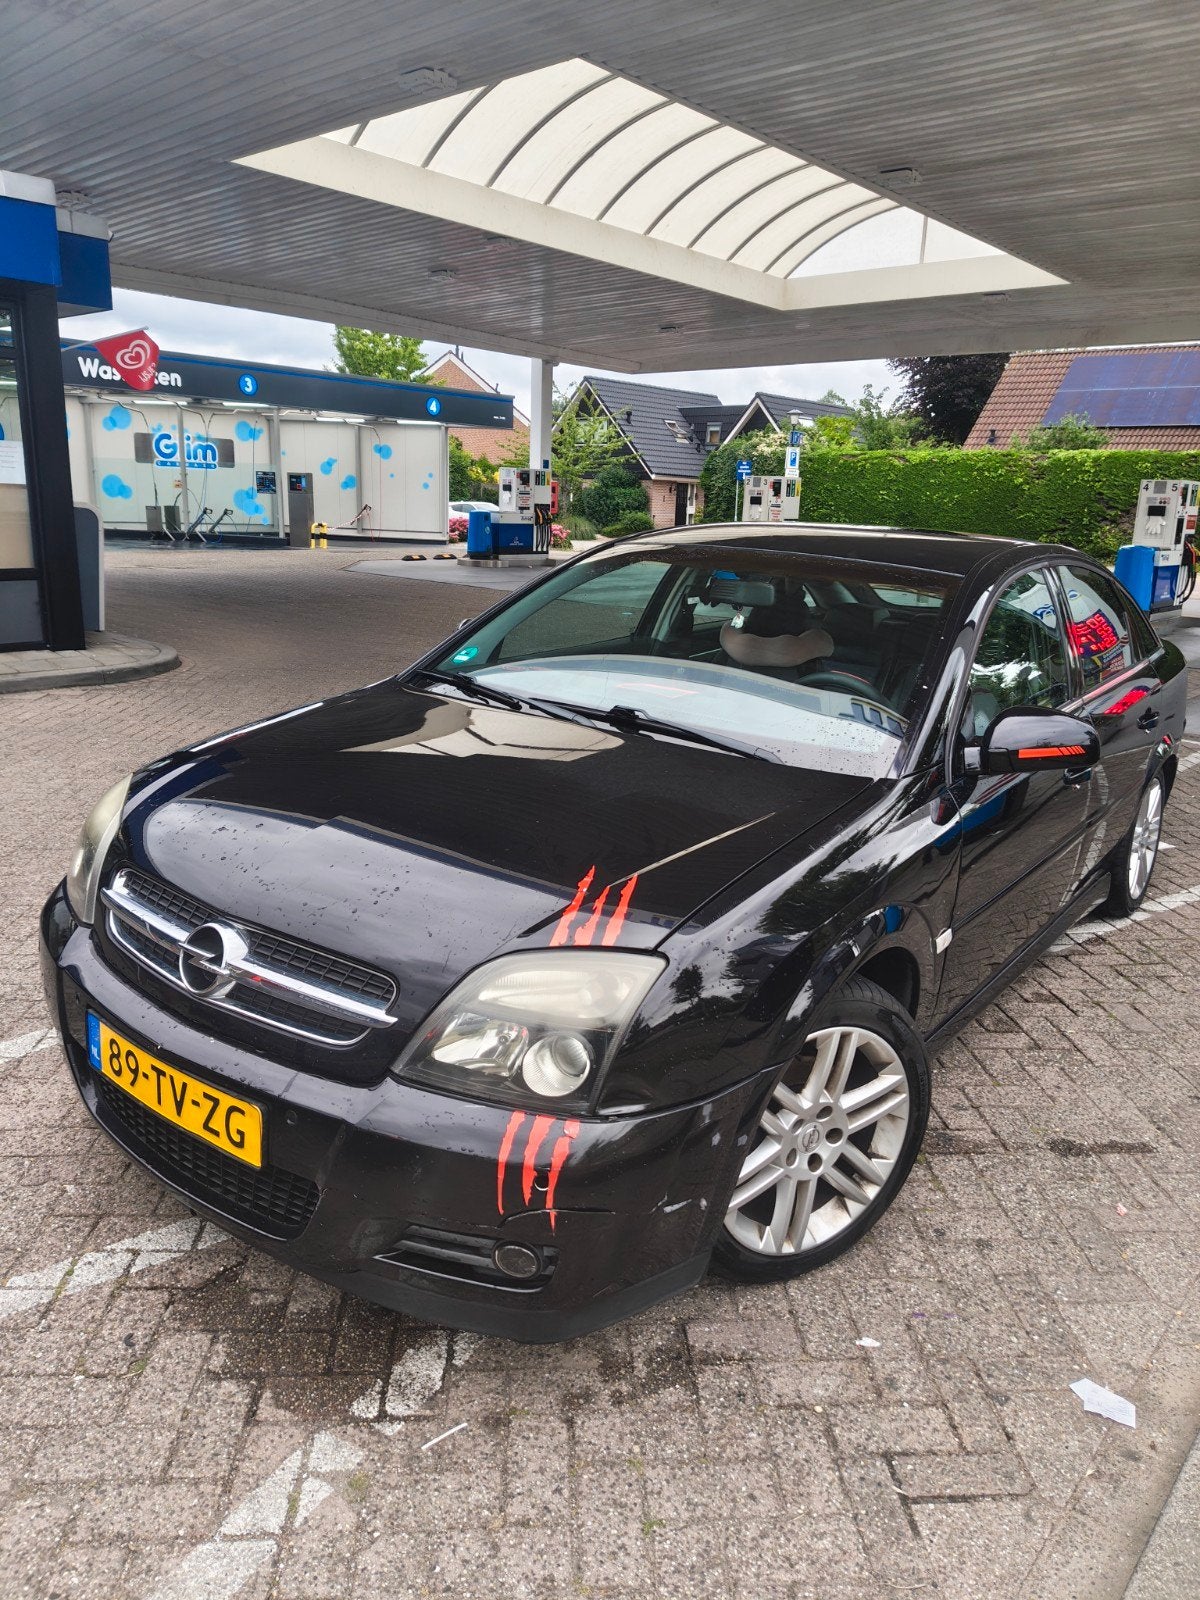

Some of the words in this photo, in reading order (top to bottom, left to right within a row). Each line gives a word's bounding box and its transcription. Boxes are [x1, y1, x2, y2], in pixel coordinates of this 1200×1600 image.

[77, 356, 182, 387] Wasen
[244, 377, 253, 393] 3
[429, 400, 437, 413] 4
[154, 433, 217, 462] Gim
[1142, 483, 1150, 492] 4
[1171, 483, 1178, 492] 5
[109, 1038, 246, 1149] 89-TV-ZG
